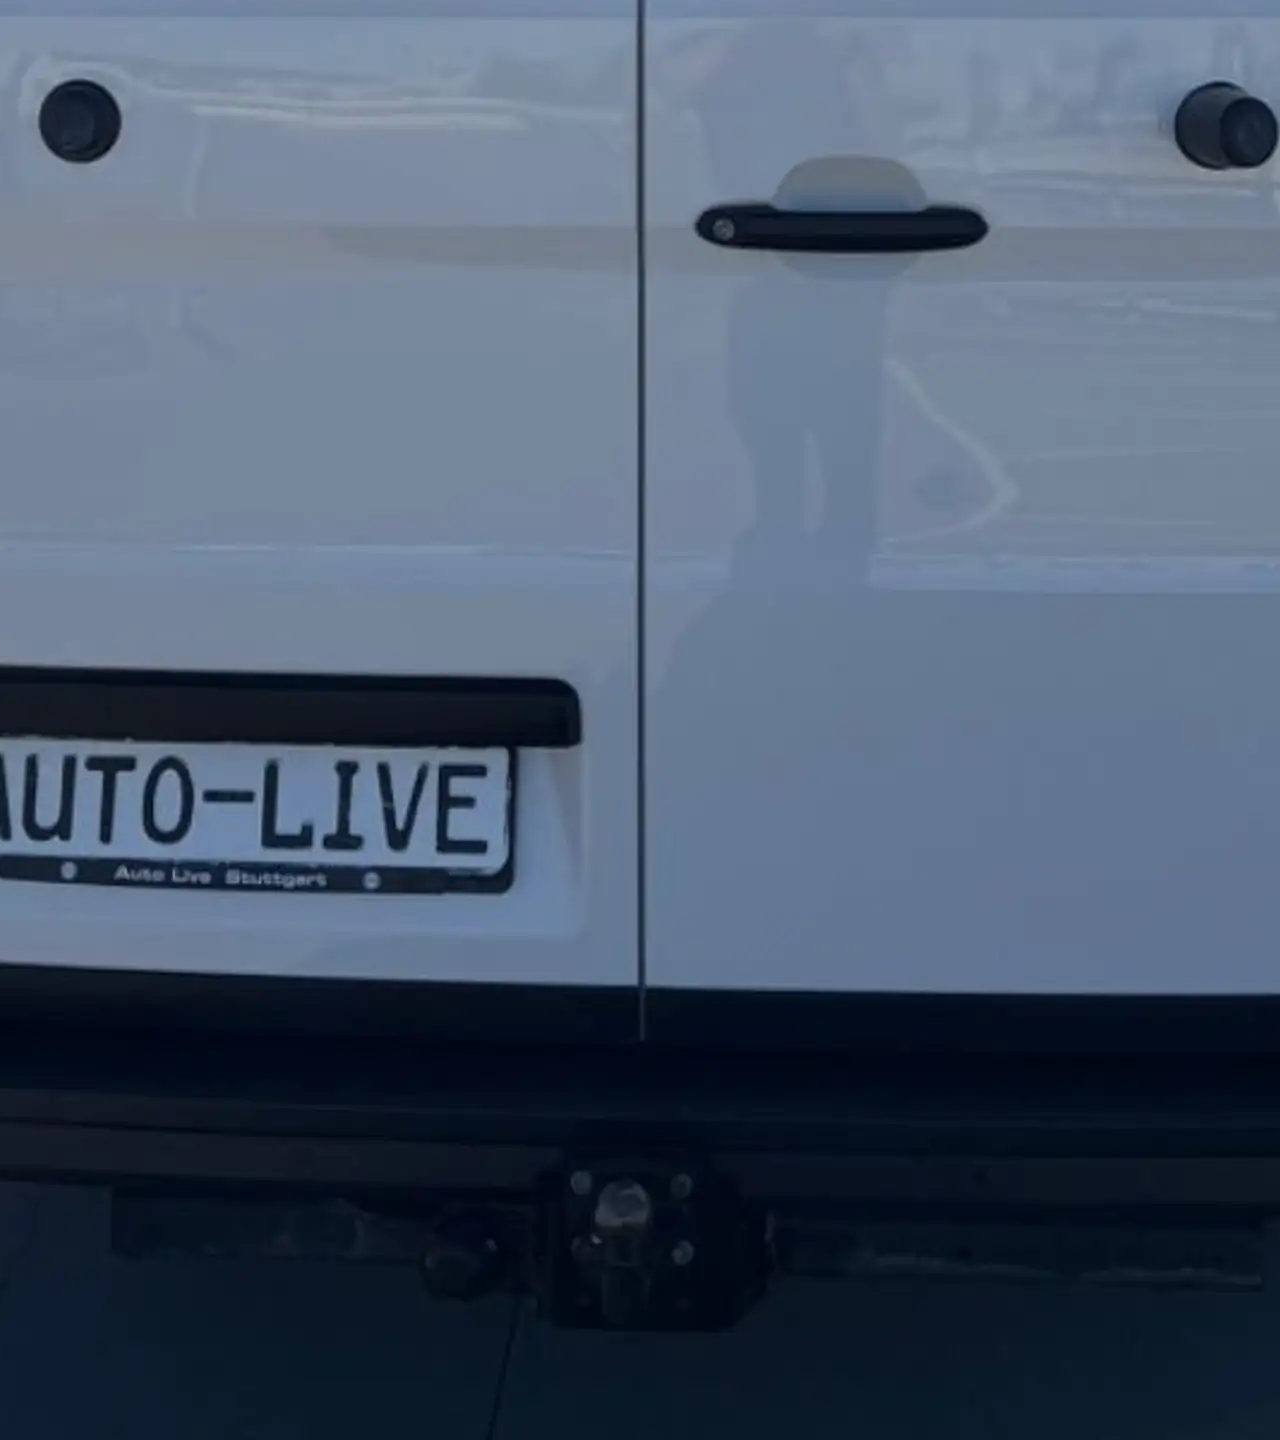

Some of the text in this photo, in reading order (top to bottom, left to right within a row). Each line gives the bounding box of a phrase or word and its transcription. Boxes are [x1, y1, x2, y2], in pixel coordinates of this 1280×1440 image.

[114, 864, 328, 889] Auto Live Stuttgart
